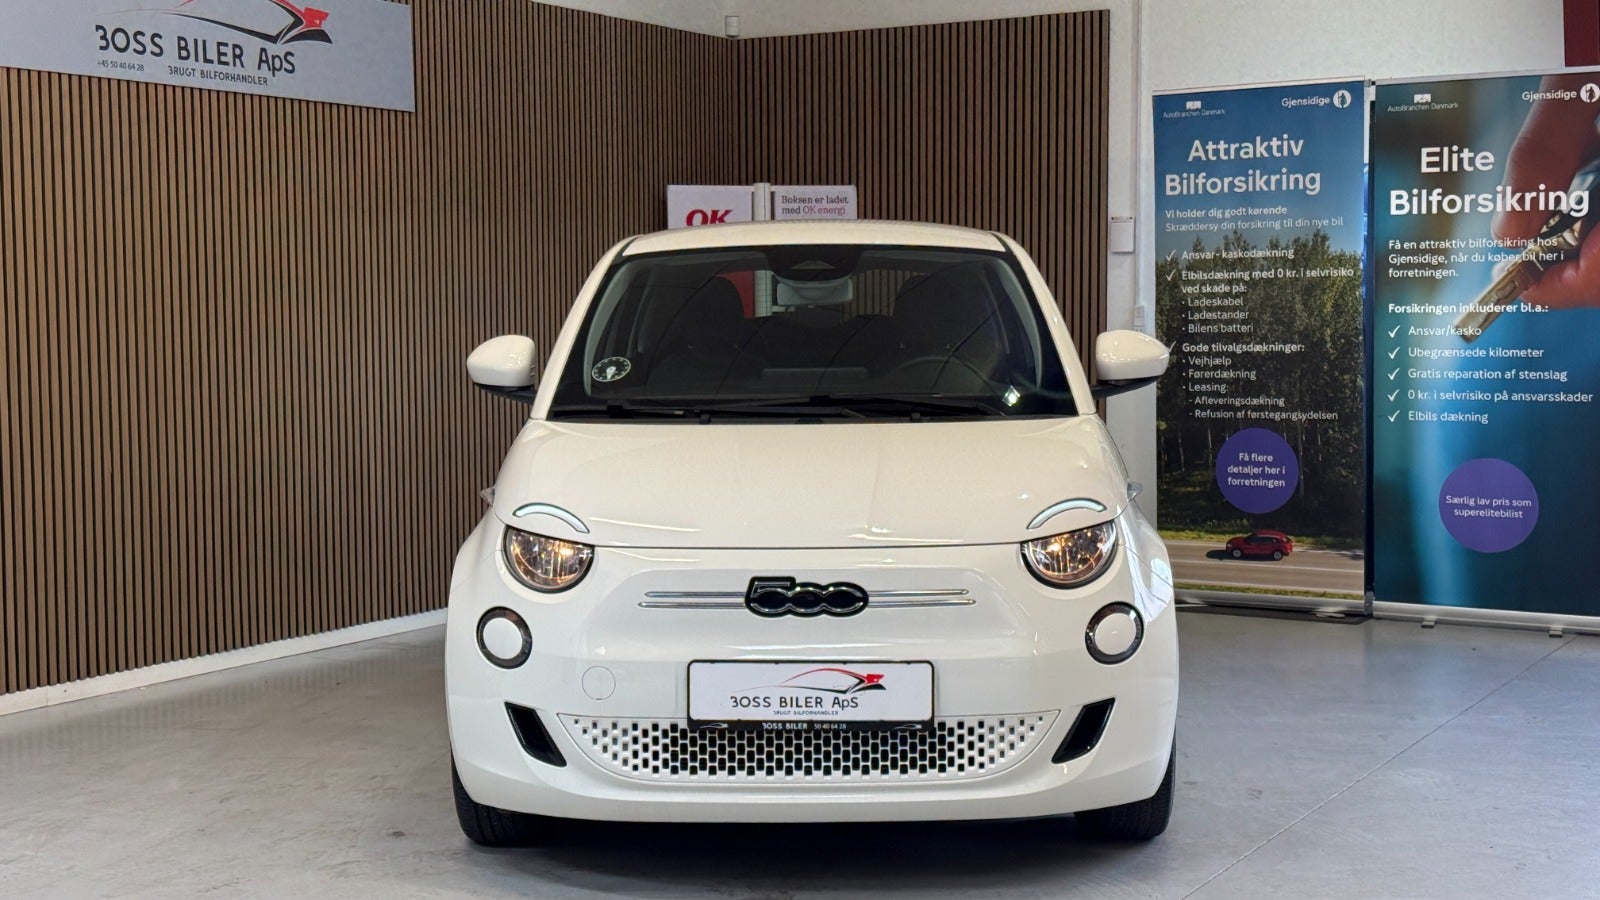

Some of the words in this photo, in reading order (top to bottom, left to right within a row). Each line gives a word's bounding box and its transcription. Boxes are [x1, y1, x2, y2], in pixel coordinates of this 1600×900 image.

[177, 36, 244, 68] BILER
[257, 48, 295, 77] ApS
[200, 69, 268, 86] BILFORHANDLER
[1282, 95, 1330, 109] Gjensidige
[1522, 89, 1577, 104] Gjensidige
[1432, 102, 1458, 110] Danmark
[1187, 134, 1304, 162] Attraktiv
[1421, 145, 1494, 173] Elite
[1166, 168, 1321, 195] Bilforsikring
[781, 195, 812, 204] Boksen
[826, 195, 848, 204] ladet
[1390, 184, 1589, 217] Bilforsikring
[782, 206, 800, 214] med
[803, 206, 816, 214] OK
[818, 206, 846, 217] energi
[1166, 210, 1175, 218] Vi
[1176, 210, 1205, 218] holder
[1208, 208, 1222, 218] dig
[1225, 208, 1246, 218] godt
[1249, 206, 1287, 216] kørende
[686, 209, 732, 226] OK
[1166, 222, 1218, 233] Skræddersy
[1221, 221, 1235, 230] din
[1238, 219, 1280, 231] forsikring
[1283, 219, 1293, 228] til
[1296, 218, 1309, 227] din
[1312, 220, 1328, 229] nye
[1331, 217, 1344, 226] bil
[1389, 240, 1400, 250] Få
[1420, 240, 1466, 249] attraktiv
[1469, 237, 1534, 250] bilforsikring
[1537, 237, 1557, 247] hos
[1222, 249, 1294, 259] kaskodækning
[1389, 254, 1448, 265] Gjensidige,
[1451, 252, 1468, 263] når
[1472, 252, 1485, 262] du
[1488, 252, 1520, 262] køber
[1522, 252, 1535, 261] bil
[1539, 251, 1558, 261] her
[1560, 251, 1564, 260] i
[1182, 270, 1250, 281] Elbilsdækning
[1252, 269, 1274, 278] med
[1278, 269, 1283, 278] 0
[1286, 269, 1298, 278] kr.
[1301, 268, 1303, 277] i
[1306, 268, 1354, 277] selvrisiko
[1389, 268, 1459, 279] forretningen.
[1182, 285, 1199, 293] ved
[1202, 284, 1230, 293] skade
[1232, 284, 1247, 294] på:
[1188, 298, 1244, 307] Ladeskabel
[1389, 304, 1456, 314] Forsikringen
[1460, 304, 1517, 313] inkluderer
[1521, 303, 1548, 313] bl.a.:
[1188, 311, 1249, 320] Ladestander
[1188, 324, 1218, 334] Bilens
[1221, 324, 1253, 333] batteri
[1408, 326, 1482, 336] Ansvar/kasko
[1182, 343, 1209, 352] Gode
[1212, 343, 1304, 353] tilvalgsdækninger:
[1408, 348, 1486, 359] Ubegrænsede
[1489, 348, 1544, 358] kilometer
[1188, 356, 1231, 367] Vejhjælp
[1189, 369, 1256, 380] Førerdækning
[1408, 369, 1441, 379] Gratis
[1444, 369, 1501, 380] reparation
[1505, 369, 1515, 379] af
[1519, 369, 1568, 382] stenslag
[1195, 397, 1284, 407] Afleveringsdækning
[1408, 390, 1415, 400] 0
[1418, 390, 1431, 400] kr.
[1434, 390, 1437, 400] i
[1440, 390, 1491, 400] selvrisiko
[1495, 391, 1508, 403] på
[1512, 392, 1593, 402] ansvarsskader
[1195, 410, 1234, 419] Refusion
[1247, 411, 1338, 421] førstegangsydelsen
[1408, 411, 1437, 421] Elbils
[1440, 411, 1488, 424] dækning
[1239, 453, 1249, 461] Få
[1251, 453, 1273, 462] flere
[1228, 465, 1262, 476] detaljer
[1265, 466, 1280, 475] her
[1282, 466, 1285, 474] i
[1228, 477, 1285, 488] forretningen
[1446, 495, 1475, 506] Særlig
[1477, 497, 1490, 505] lav
[1493, 497, 1510, 507] pris
[1454, 508, 1523, 518] superelitebilist
[747, 578, 867, 616] 500
[780, 696, 823, 708] BILER
[832, 696, 858, 711] ApS
